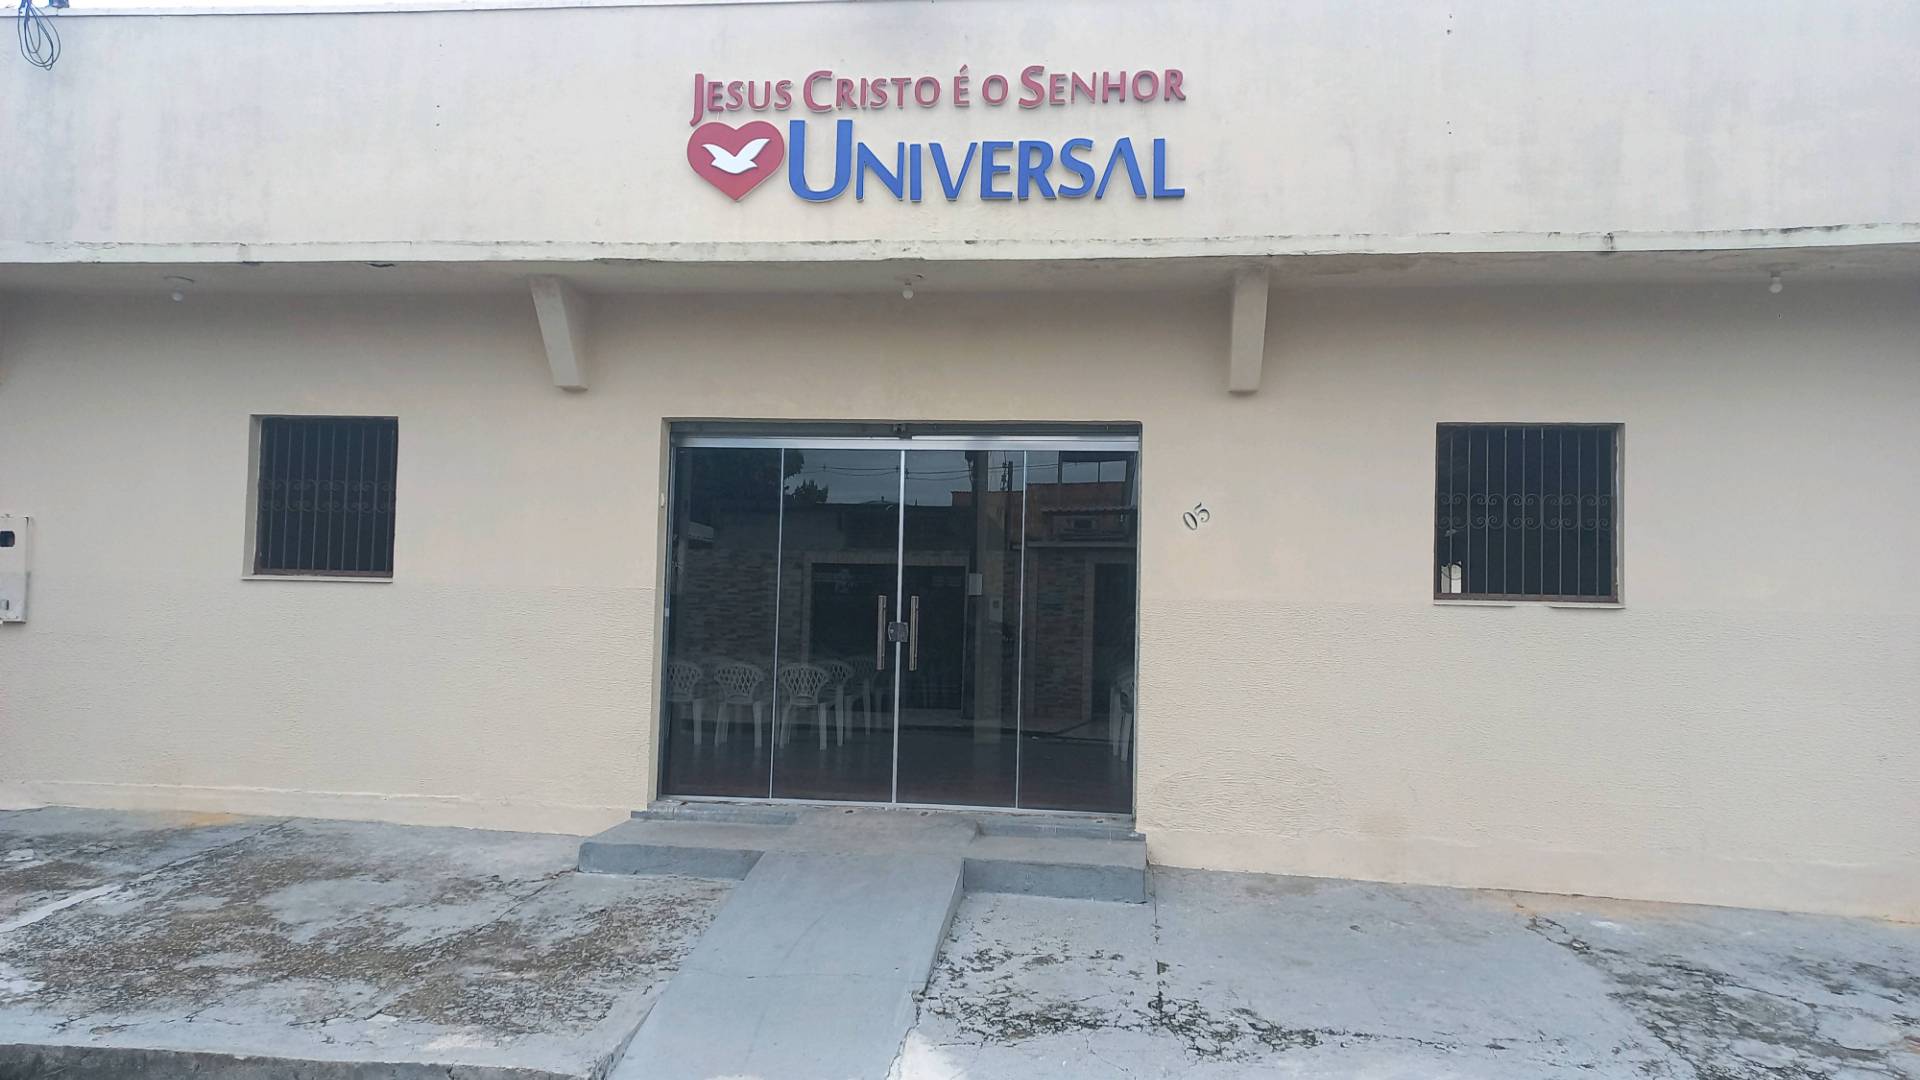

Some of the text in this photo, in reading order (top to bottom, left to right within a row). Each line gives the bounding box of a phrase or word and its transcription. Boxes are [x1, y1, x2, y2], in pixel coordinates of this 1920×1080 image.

[689, 64, 1186, 127] JESUS CRISTO É O SENHOR
[788, 119, 1186, 203] UNIVERSAL
[1183, 501, 1211, 531] 05
